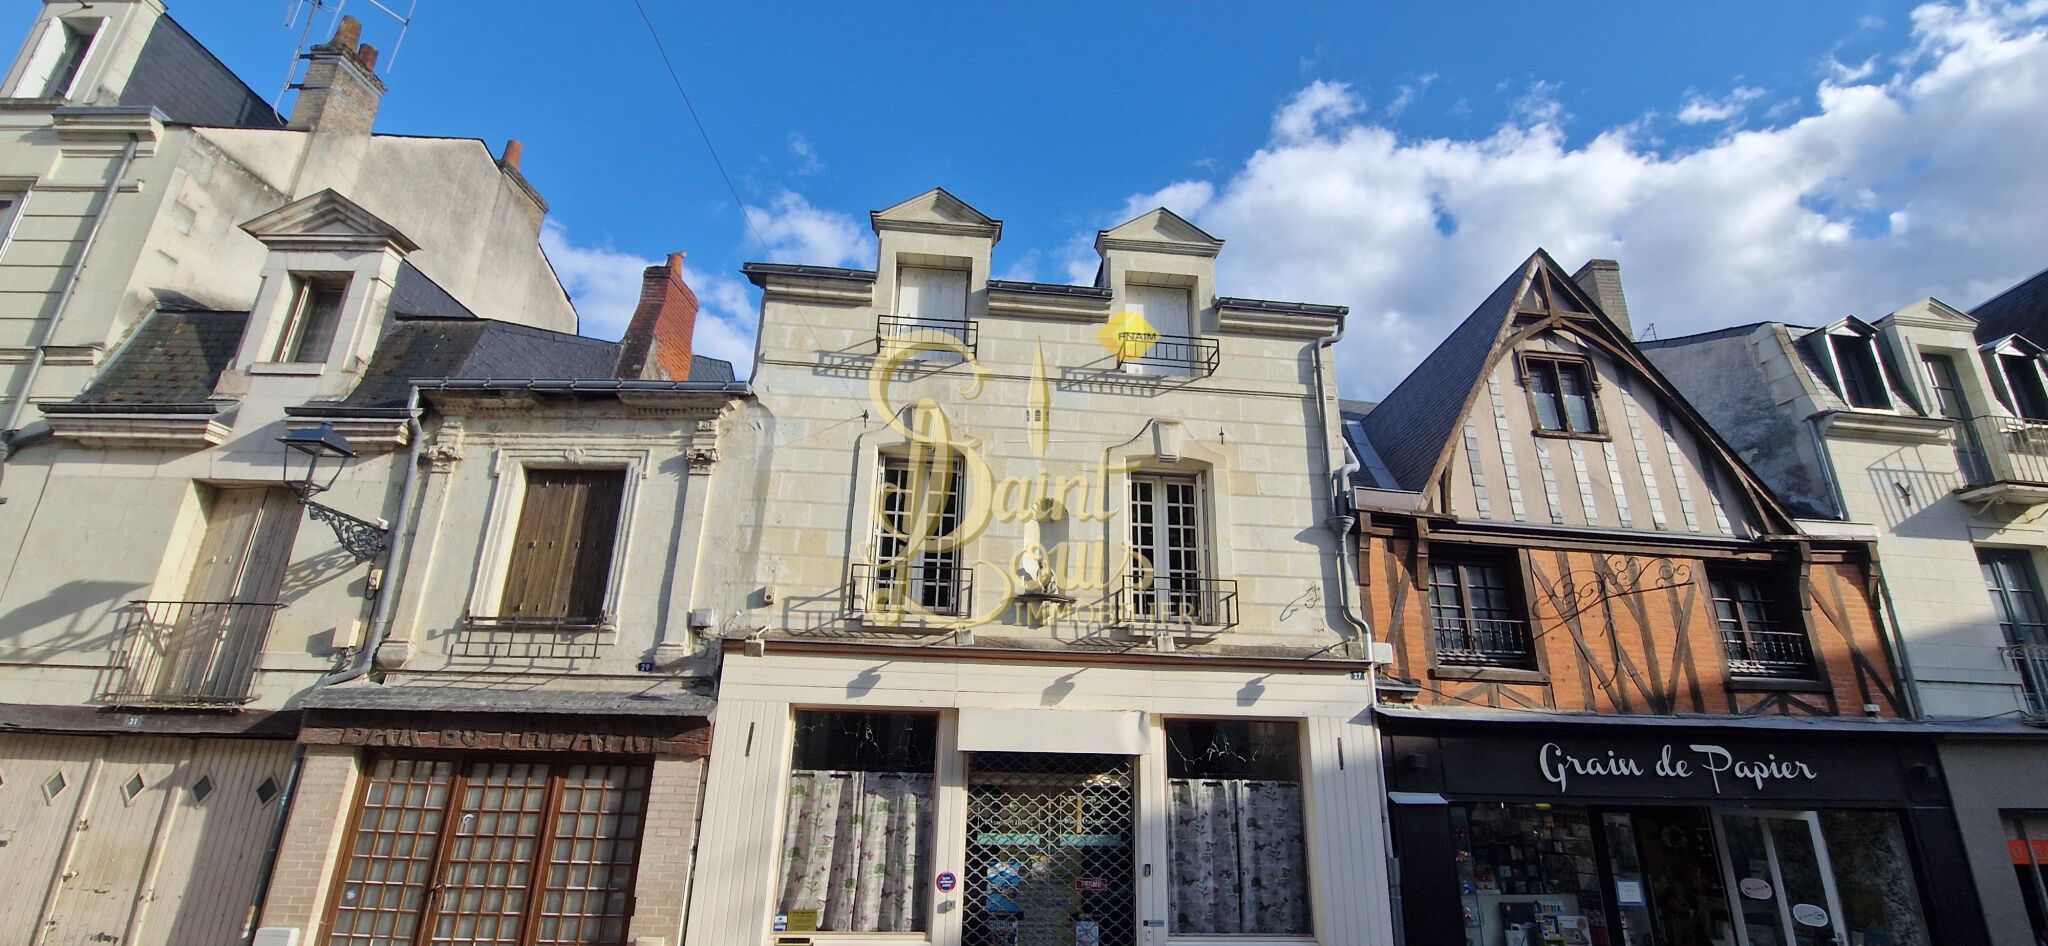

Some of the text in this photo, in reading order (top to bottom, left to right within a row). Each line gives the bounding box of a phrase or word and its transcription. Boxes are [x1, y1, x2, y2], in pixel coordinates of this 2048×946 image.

[1539, 742, 1817, 794] Grain de Papier
